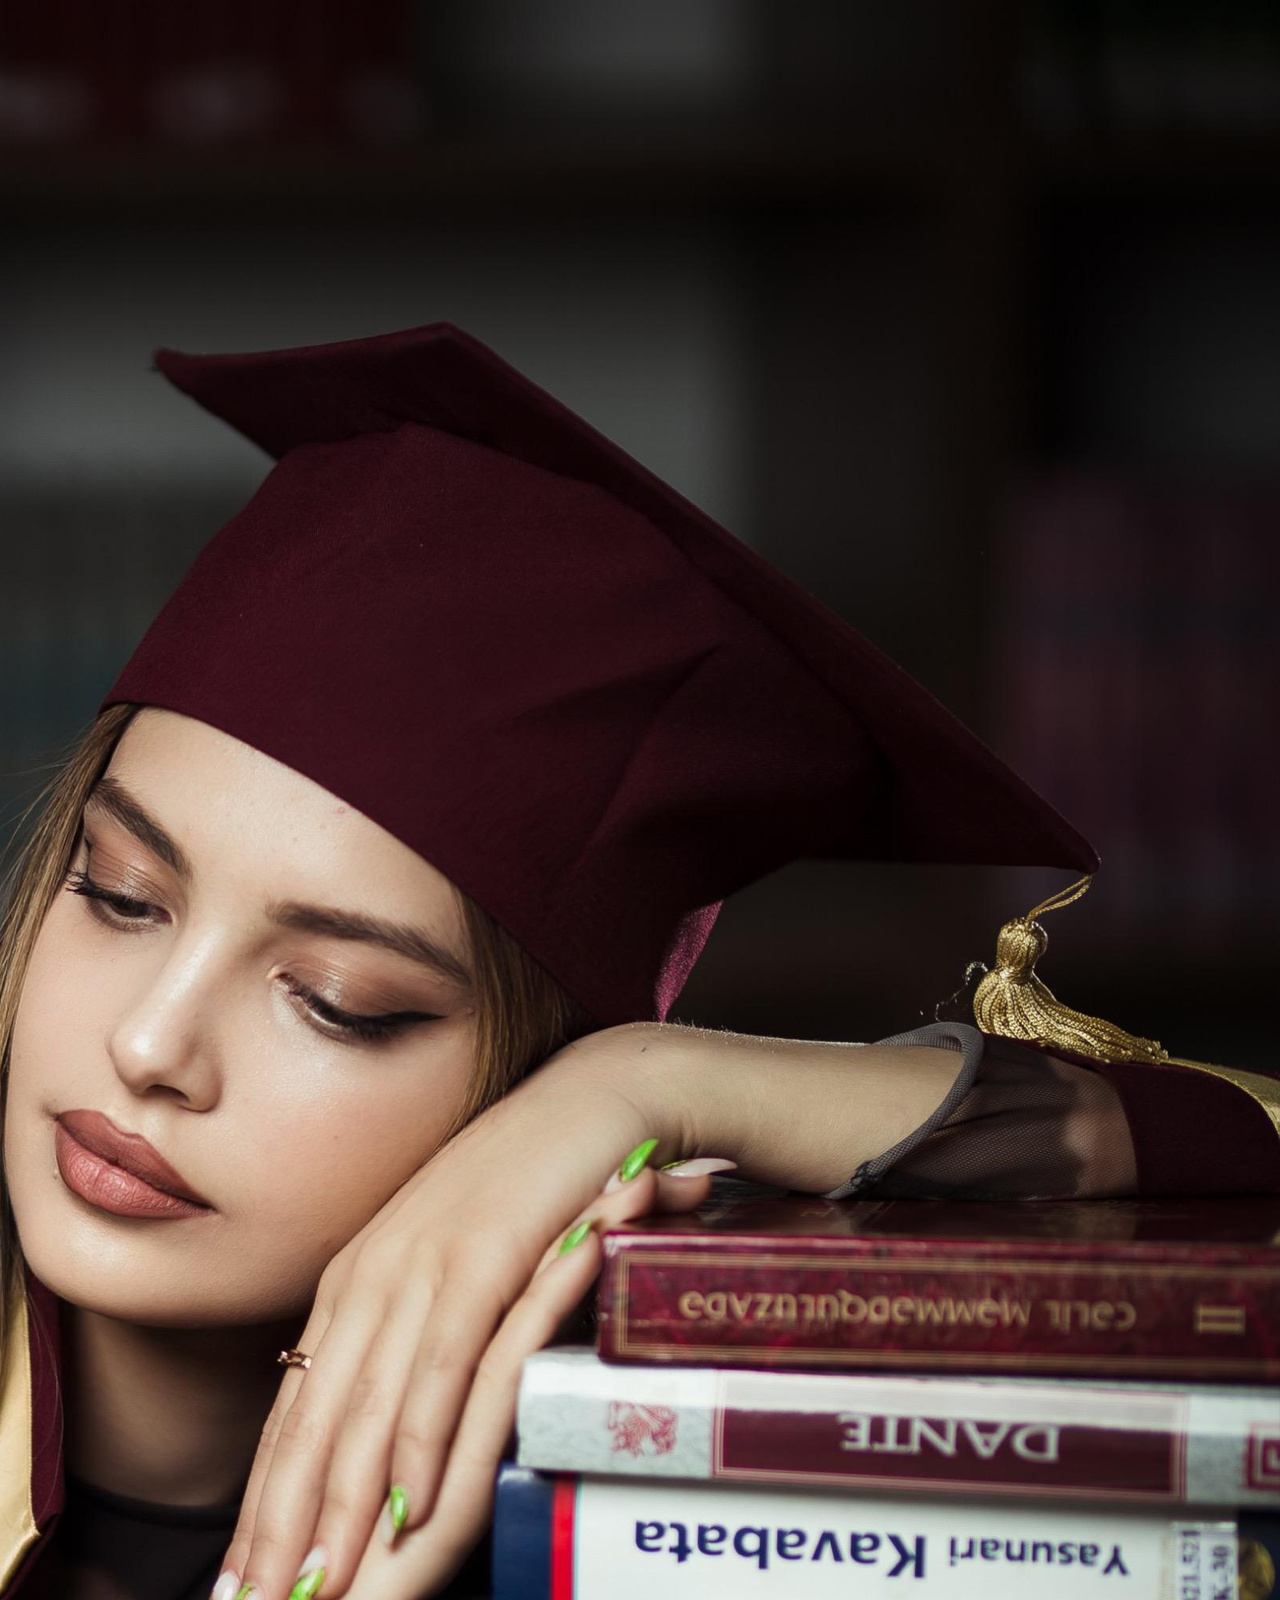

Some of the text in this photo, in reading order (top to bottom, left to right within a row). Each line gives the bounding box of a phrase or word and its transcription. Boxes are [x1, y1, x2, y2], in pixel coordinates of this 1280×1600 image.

[840, 1413, 1060, 1464] DANTE
[633, 1520, 927, 1579] Kavabata
[949, 1537, 1132, 1578] Yasunari
